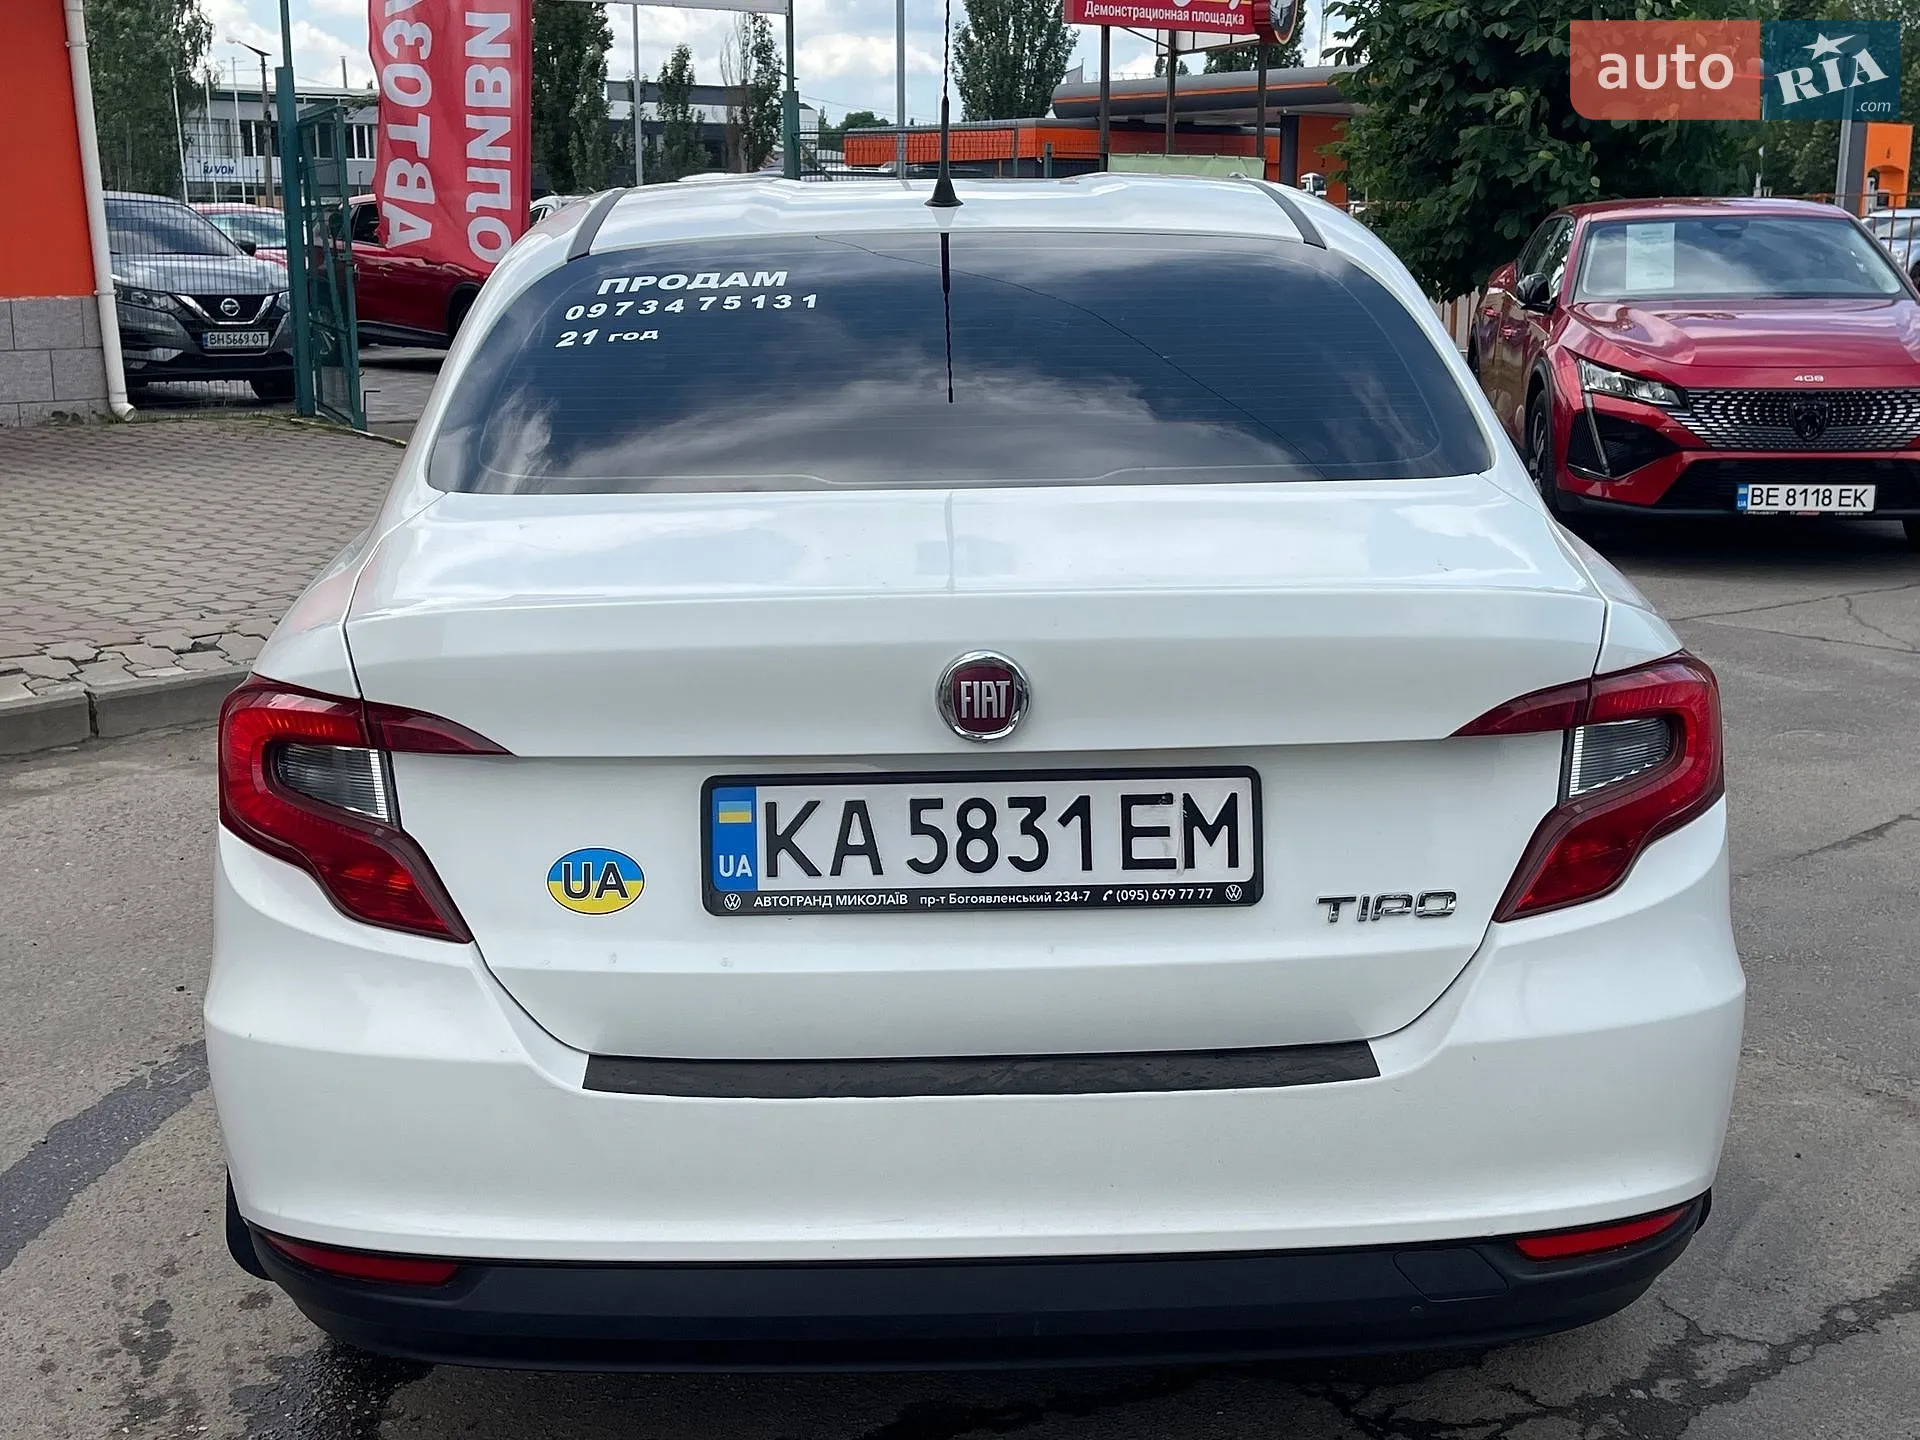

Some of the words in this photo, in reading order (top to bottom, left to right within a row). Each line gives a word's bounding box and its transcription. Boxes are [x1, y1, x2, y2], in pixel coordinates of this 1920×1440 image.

[1084, 1, 1189, 21] Демонстрационная
[1191, 10, 1245, 26] площадка
[597, 271, 788, 296] ПРОДАМ
[555, 329, 599, 348] 21
[607, 329, 659, 343] год
[1750, 487, 1779, 506] BE
[1785, 488, 1832, 507] 8118
[1838, 488, 1868, 508] EK
[960, 680, 1011, 719] FIAT
[718, 854, 753, 878] UA
[764, 798, 884, 878] KA
[905, 794, 1093, 875] 5831
[1121, 791, 1240, 873] EM
[562, 861, 631, 900] UA
[753, 896, 833, 909] АВТОГРАНД
[835, 891, 908, 907] МИКОЛАЇВ
[919, 895, 945, 906] пр-т
[949, 891, 1052, 906] Богоявленський
[1055, 890, 1091, 903] 234-7
[1116, 888, 1150, 902] (095)
[1152, 888, 1176, 901] 679
[1179, 887, 1194, 900] 77
[1197, 887, 1214, 900] 77
[1316, 889, 1457, 923] TIPO
